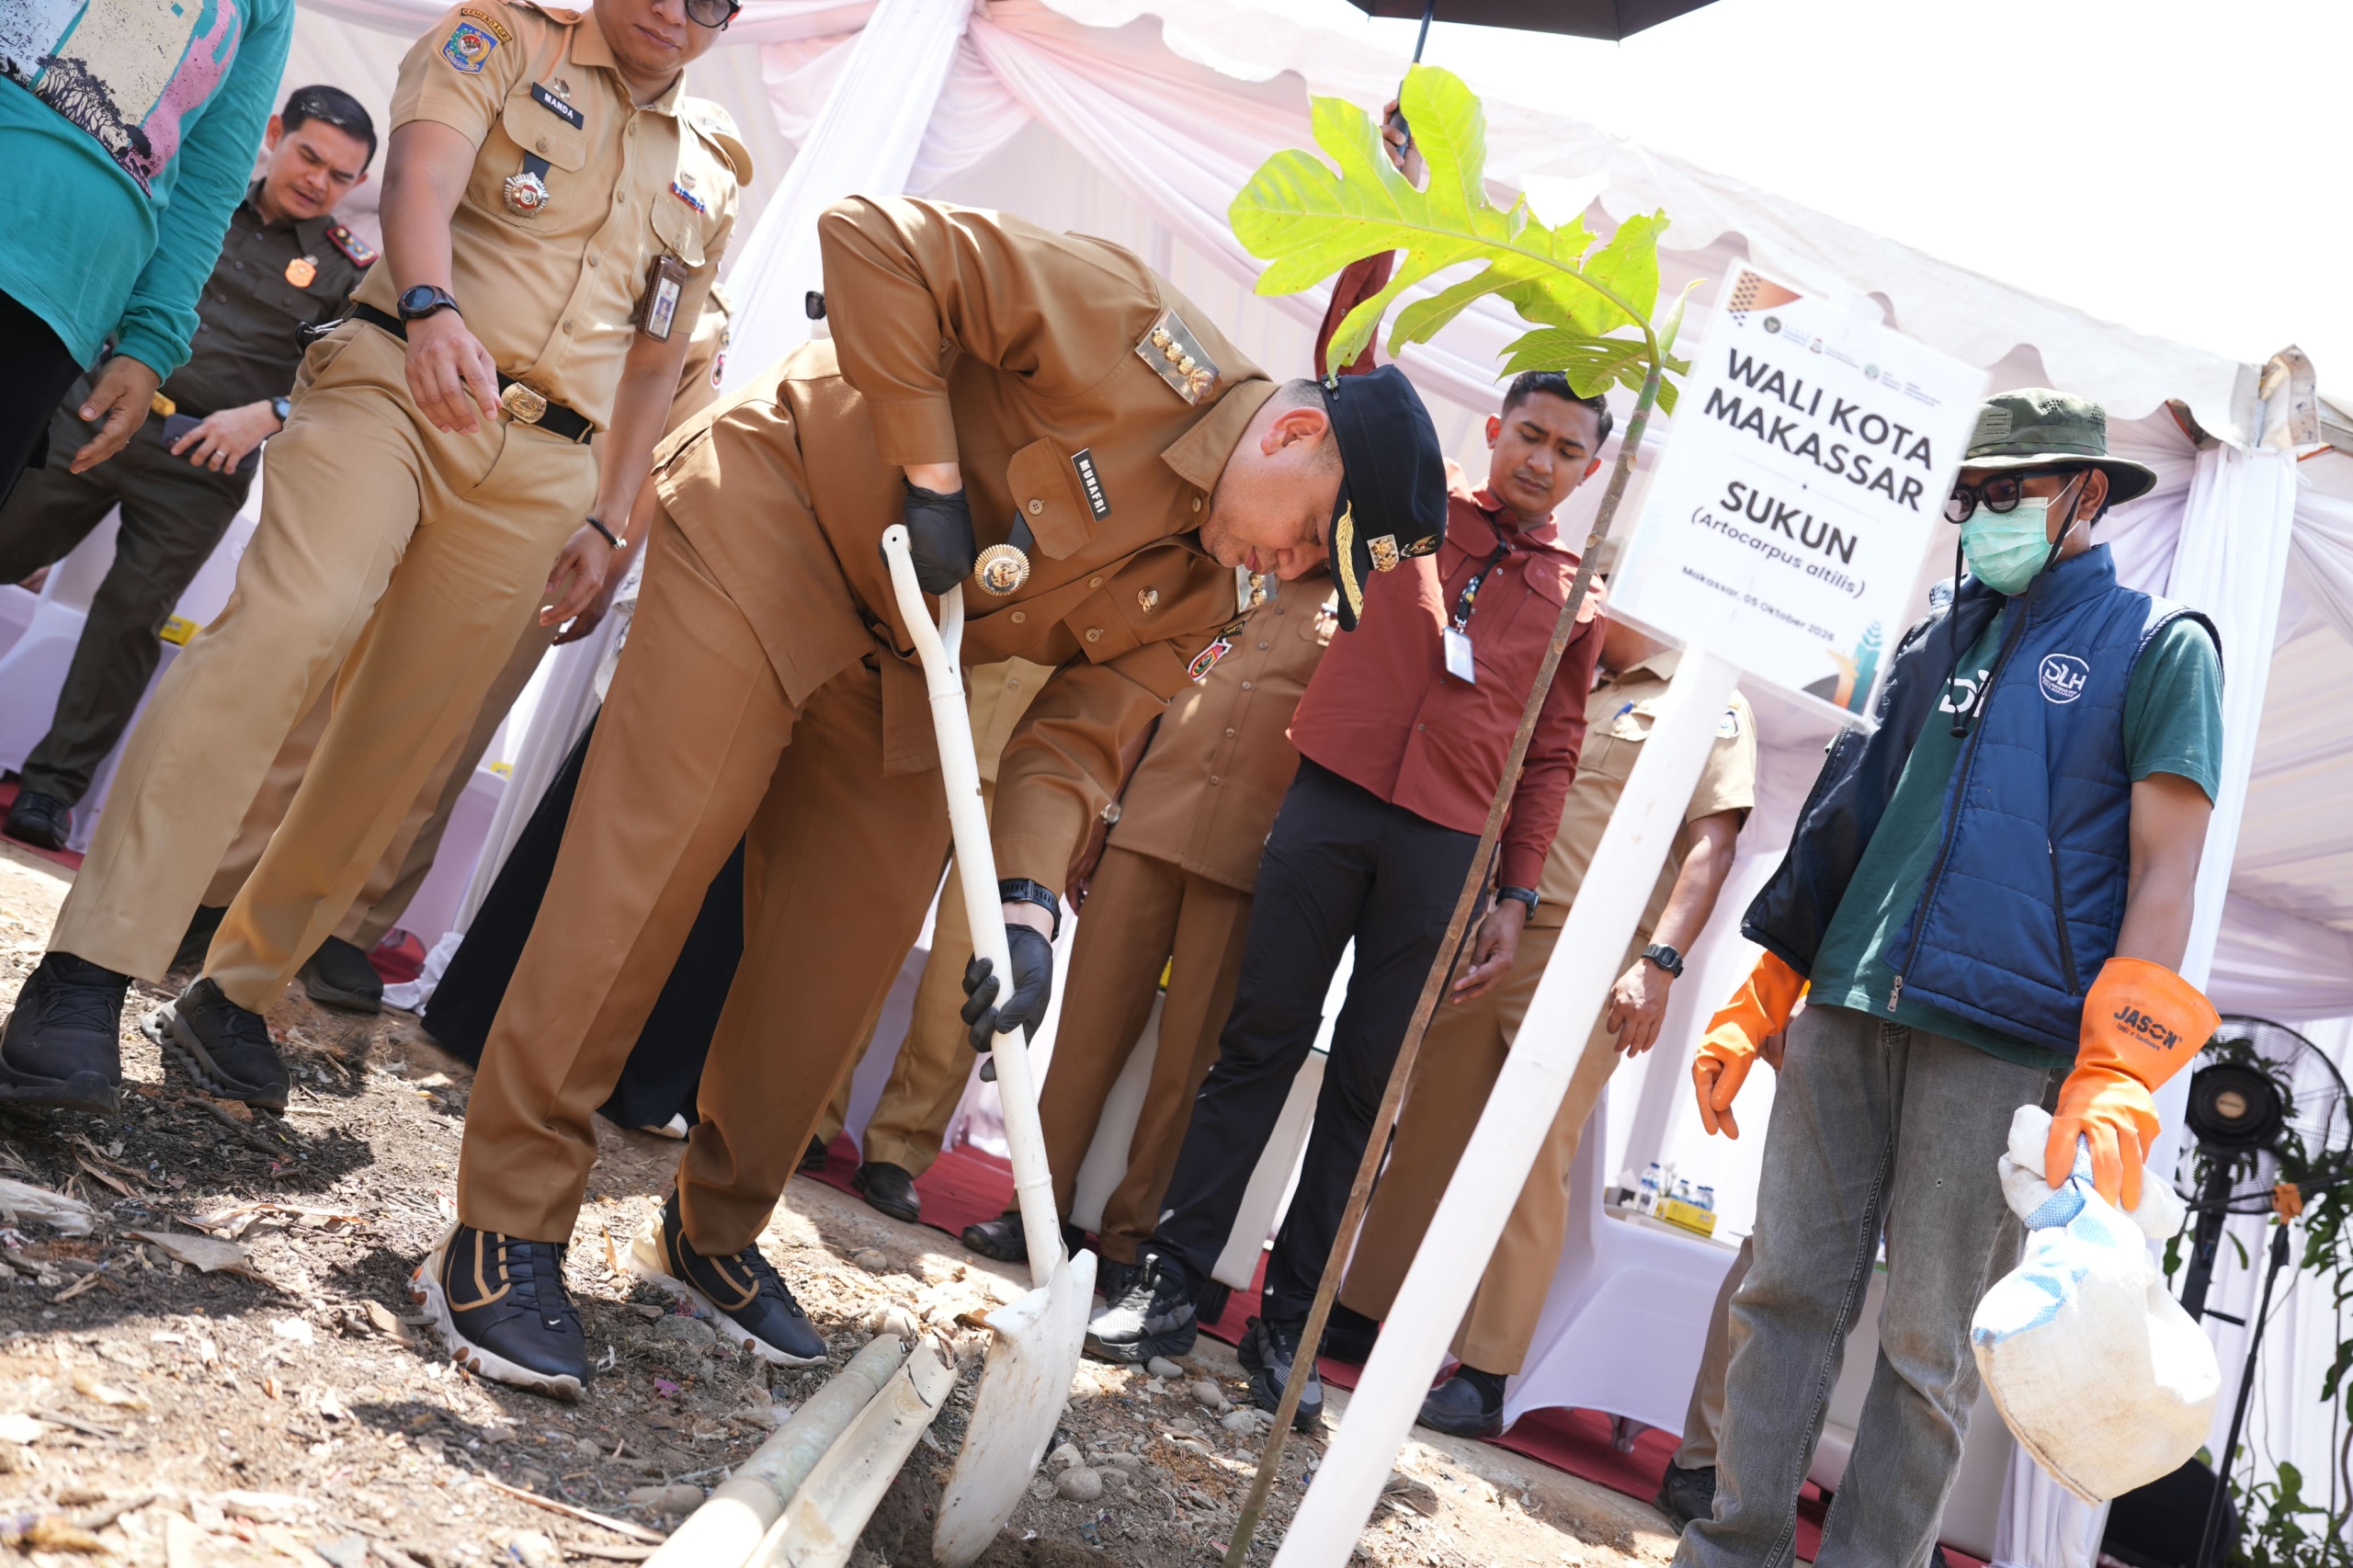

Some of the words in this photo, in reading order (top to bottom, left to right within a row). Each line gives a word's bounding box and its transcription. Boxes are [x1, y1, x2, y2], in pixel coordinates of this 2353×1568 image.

[463, 9, 510, 41] KEMENDAGRI
[544, 93, 574, 119] MANDA
[1729, 347, 1823, 416] WALI
[1829, 397, 1931, 471] KOTA
[1704, 387, 1924, 512] MAKASSAR
[1079, 459, 1106, 513] MUNAFRI
[1720, 481, 1858, 564] SUKUN
[1691, 506, 1802, 568] (Artocarpus
[1806, 565, 1866, 598] altilis)
[1760, 602, 1805, 629] Oktober
[2044, 659, 2087, 691] DLH
[2113, 1006, 2178, 1051] JASON
[2135, 1033, 2161, 1051] hardware
